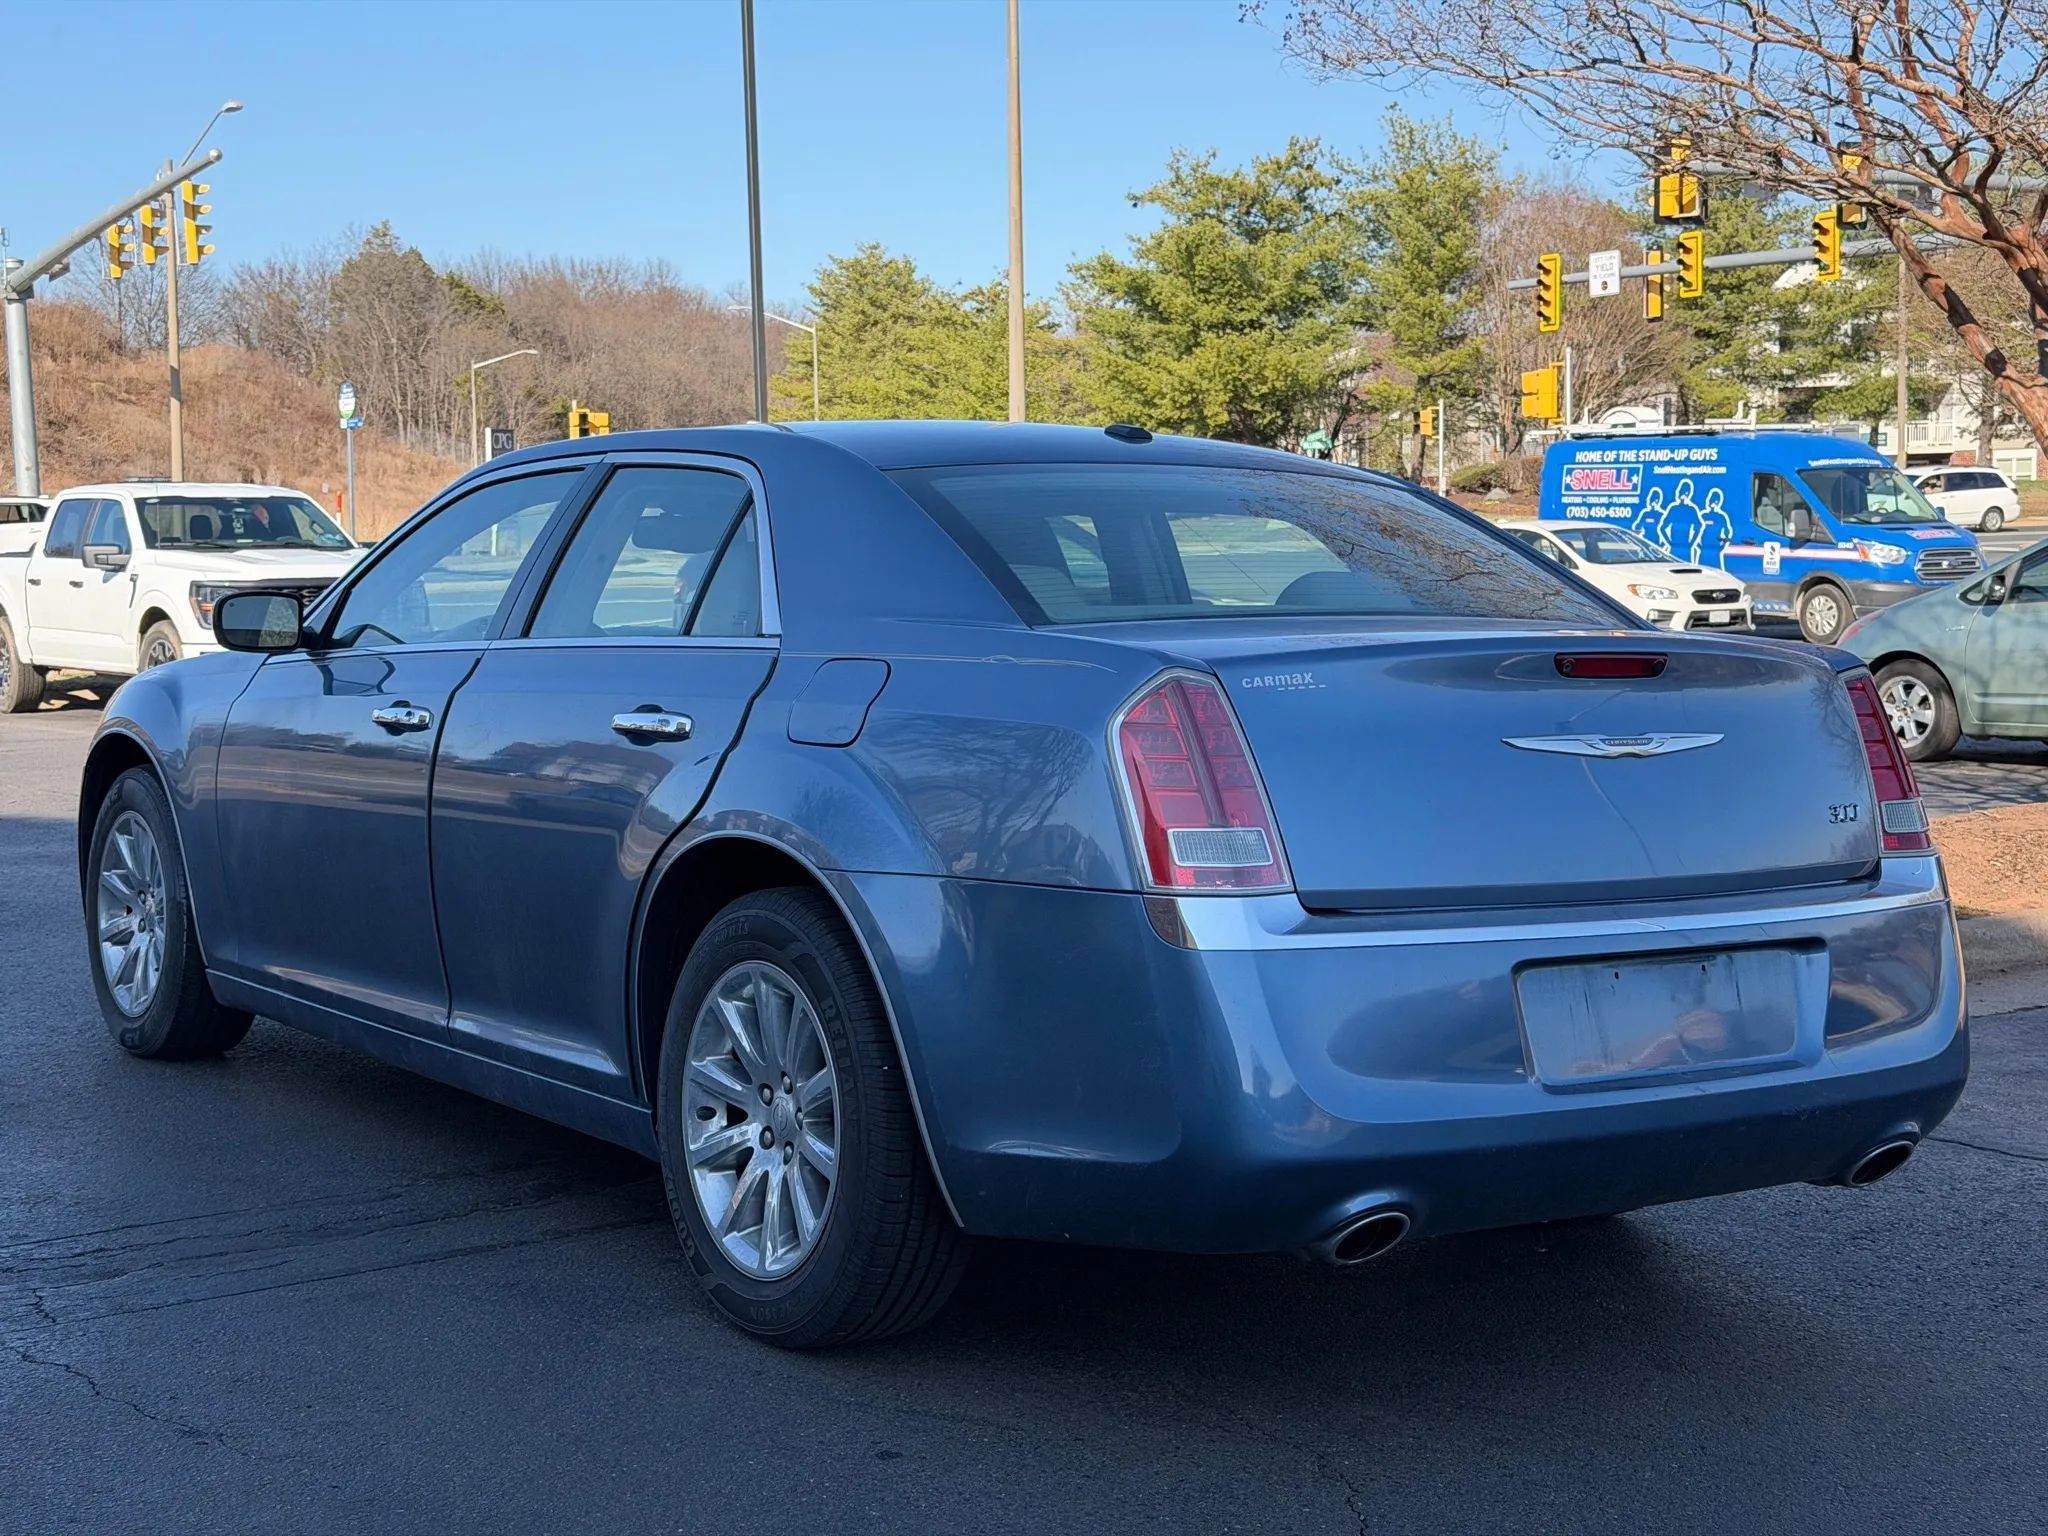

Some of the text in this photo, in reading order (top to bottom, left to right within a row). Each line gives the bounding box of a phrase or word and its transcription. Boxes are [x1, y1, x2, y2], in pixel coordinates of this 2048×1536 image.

[1575, 448, 1718, 463] HOME OF THE STAND-UP GUYS
[1571, 469, 1632, 490] SNELL
[1566, 506, 1632, 518] (703) 450-6300
[1828, 803, 1858, 824] 300
